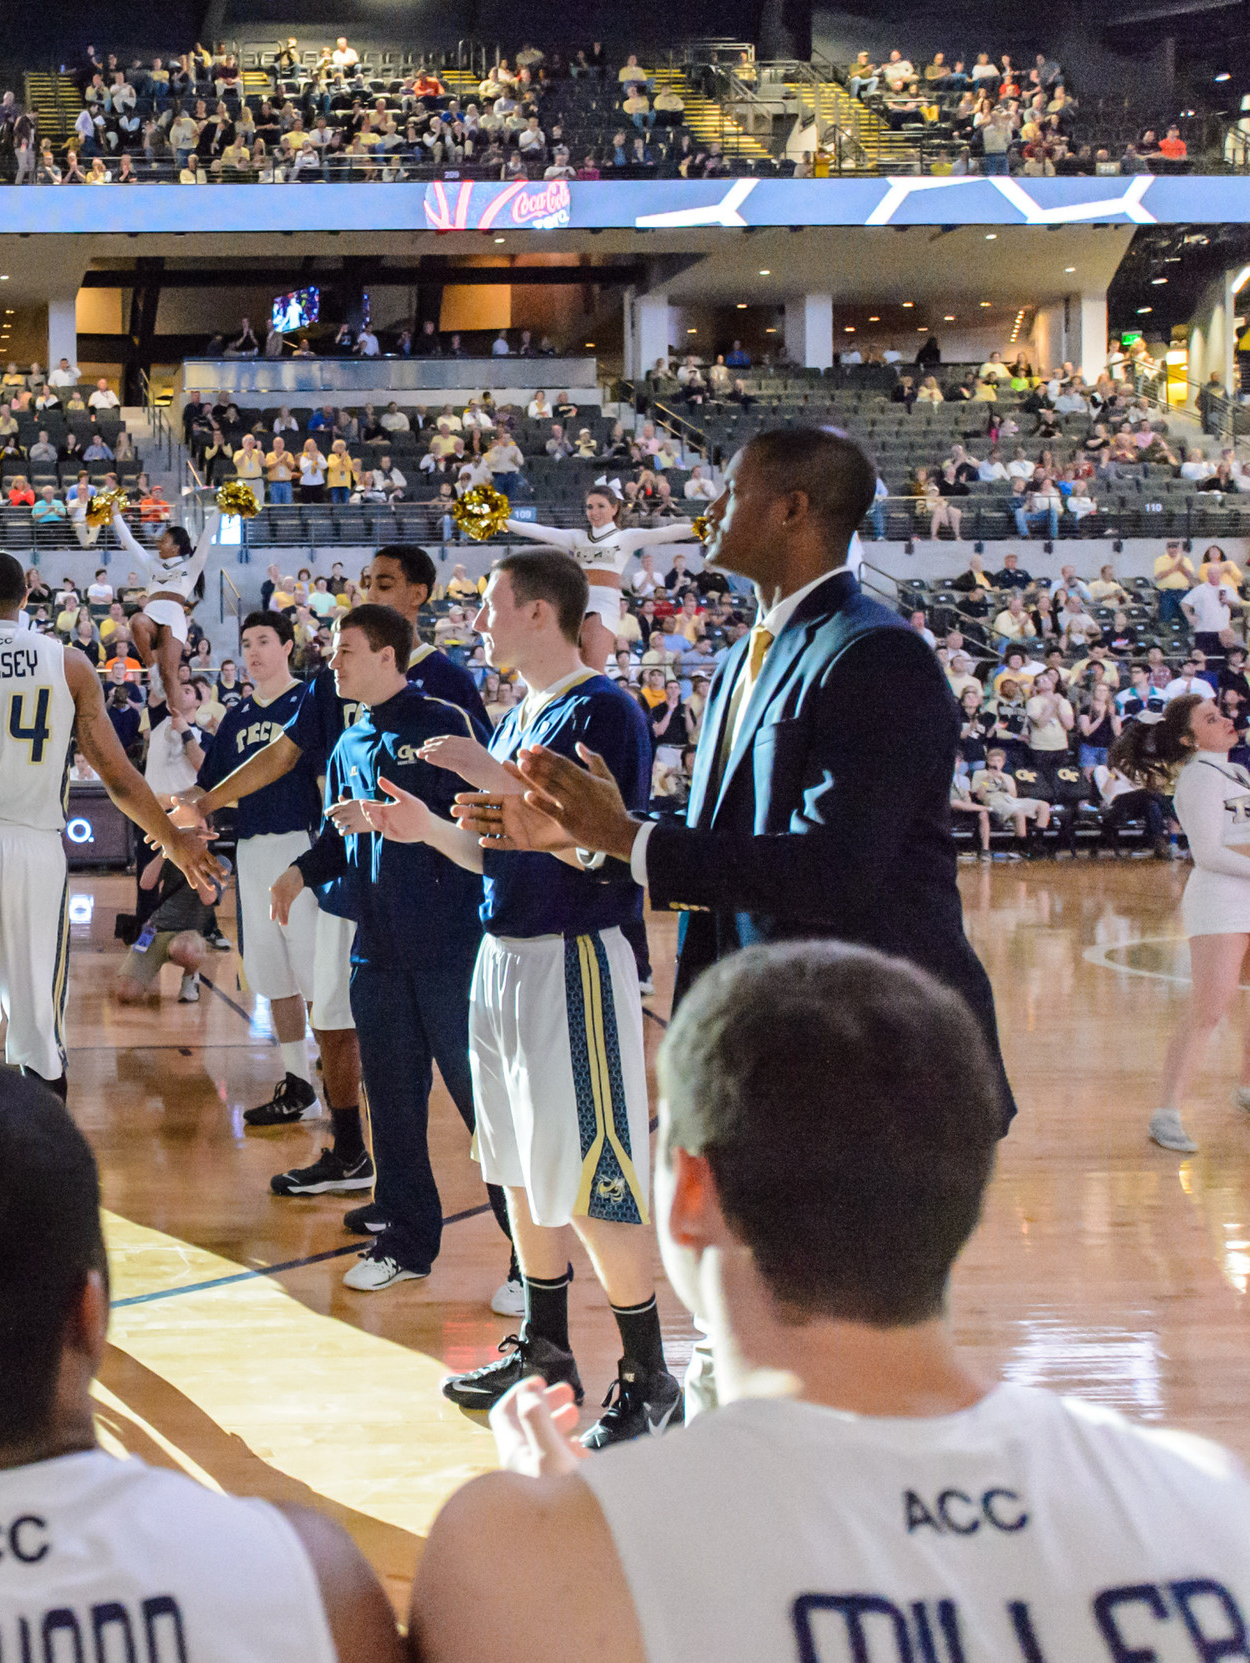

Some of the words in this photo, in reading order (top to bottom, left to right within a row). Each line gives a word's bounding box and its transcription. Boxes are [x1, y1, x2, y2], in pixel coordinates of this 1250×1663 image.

[1145, 503, 1162, 513] 110
[514, 510, 532, 519] 109
[903, 1487, 1029, 1536] ACC
